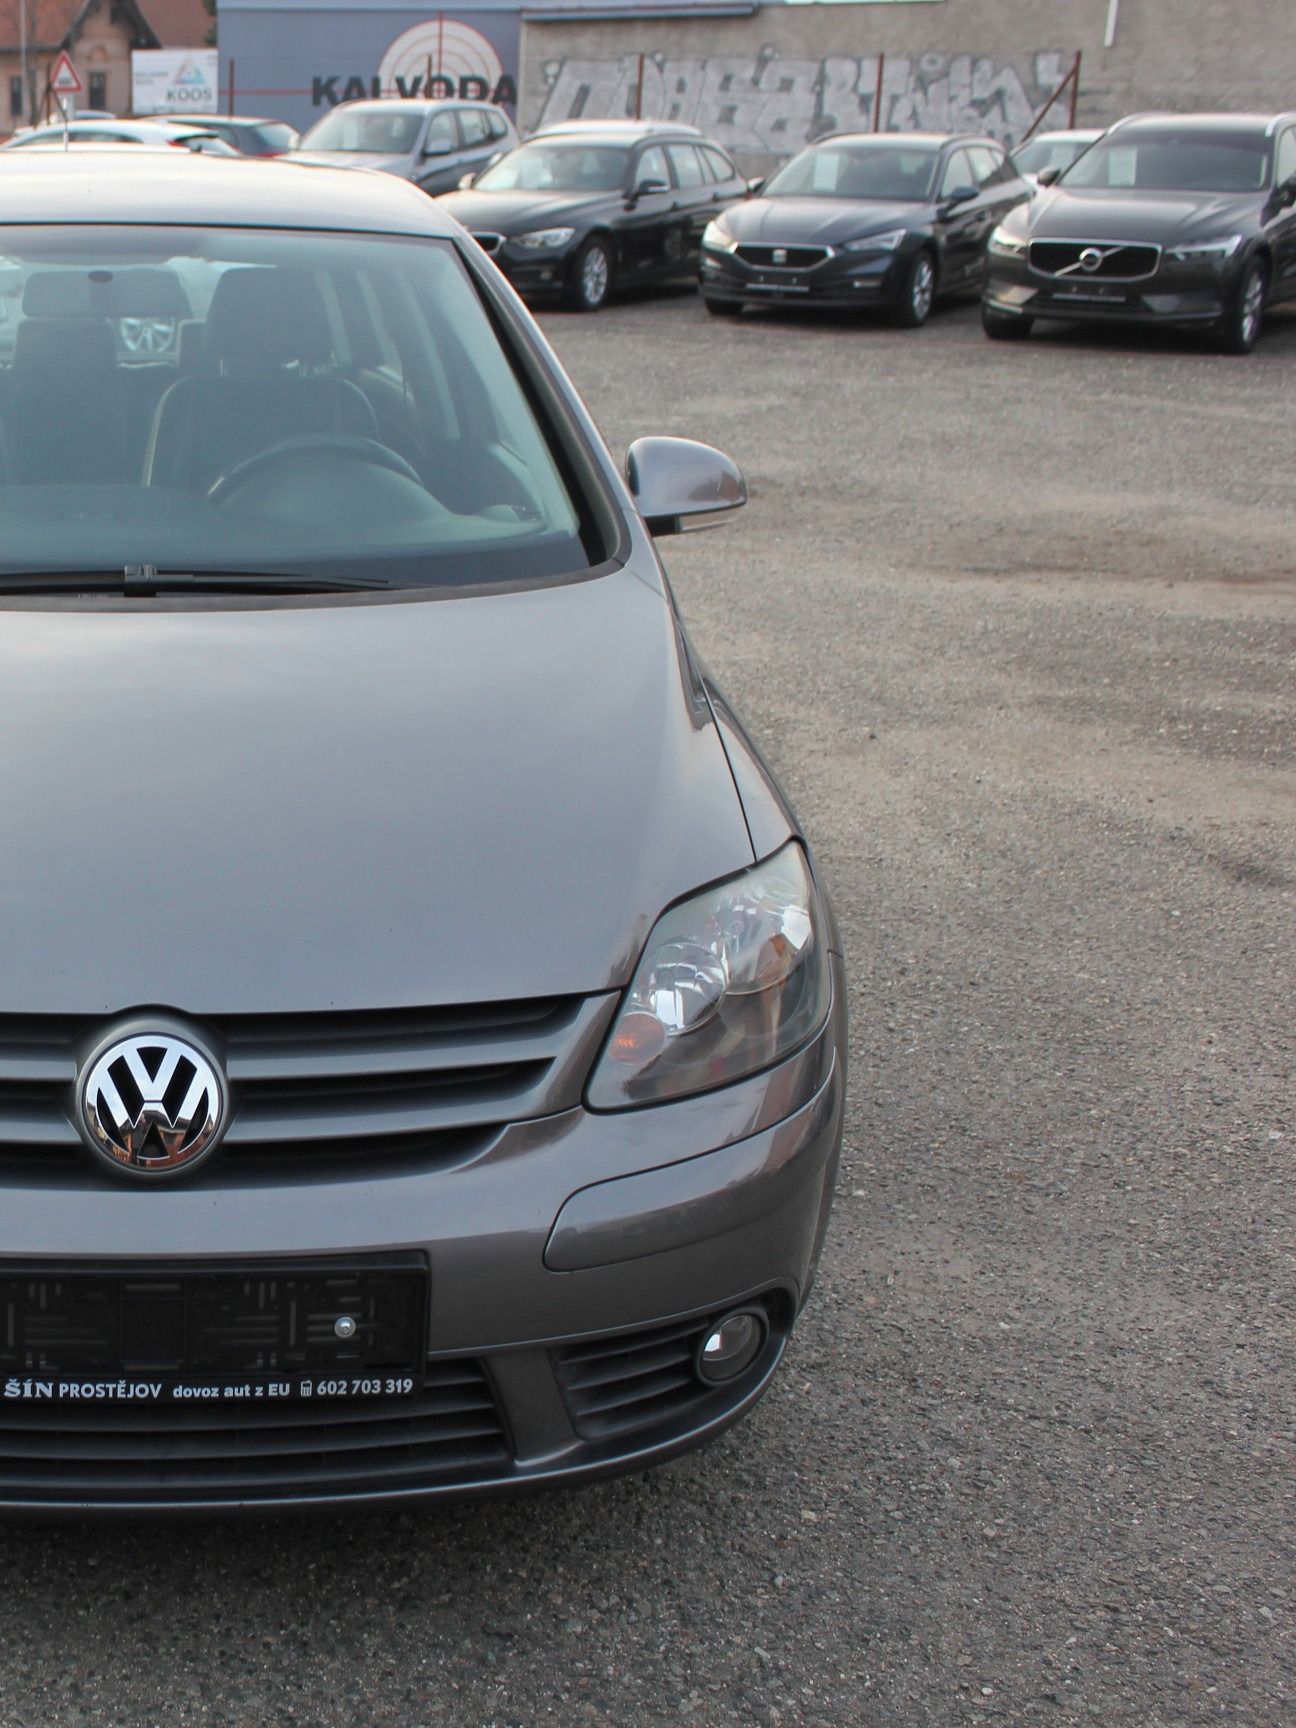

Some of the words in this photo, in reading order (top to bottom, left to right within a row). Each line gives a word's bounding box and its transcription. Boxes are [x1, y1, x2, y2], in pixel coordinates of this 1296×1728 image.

[166, 87, 213, 101] KOOS
[4, 1379, 54, 1398] ŠÍN
[59, 1379, 162, 1398] PROSTĚJOV
[173, 1384, 219, 1398] dovoz
[224, 1383, 251, 1397] aut
[255, 1386, 264, 1396] z
[268, 1383, 290, 1396] EU
[317, 1380, 347, 1395] 602
[352, 1379, 381, 1394] 703
[385, 1378, 413, 1393] 319
